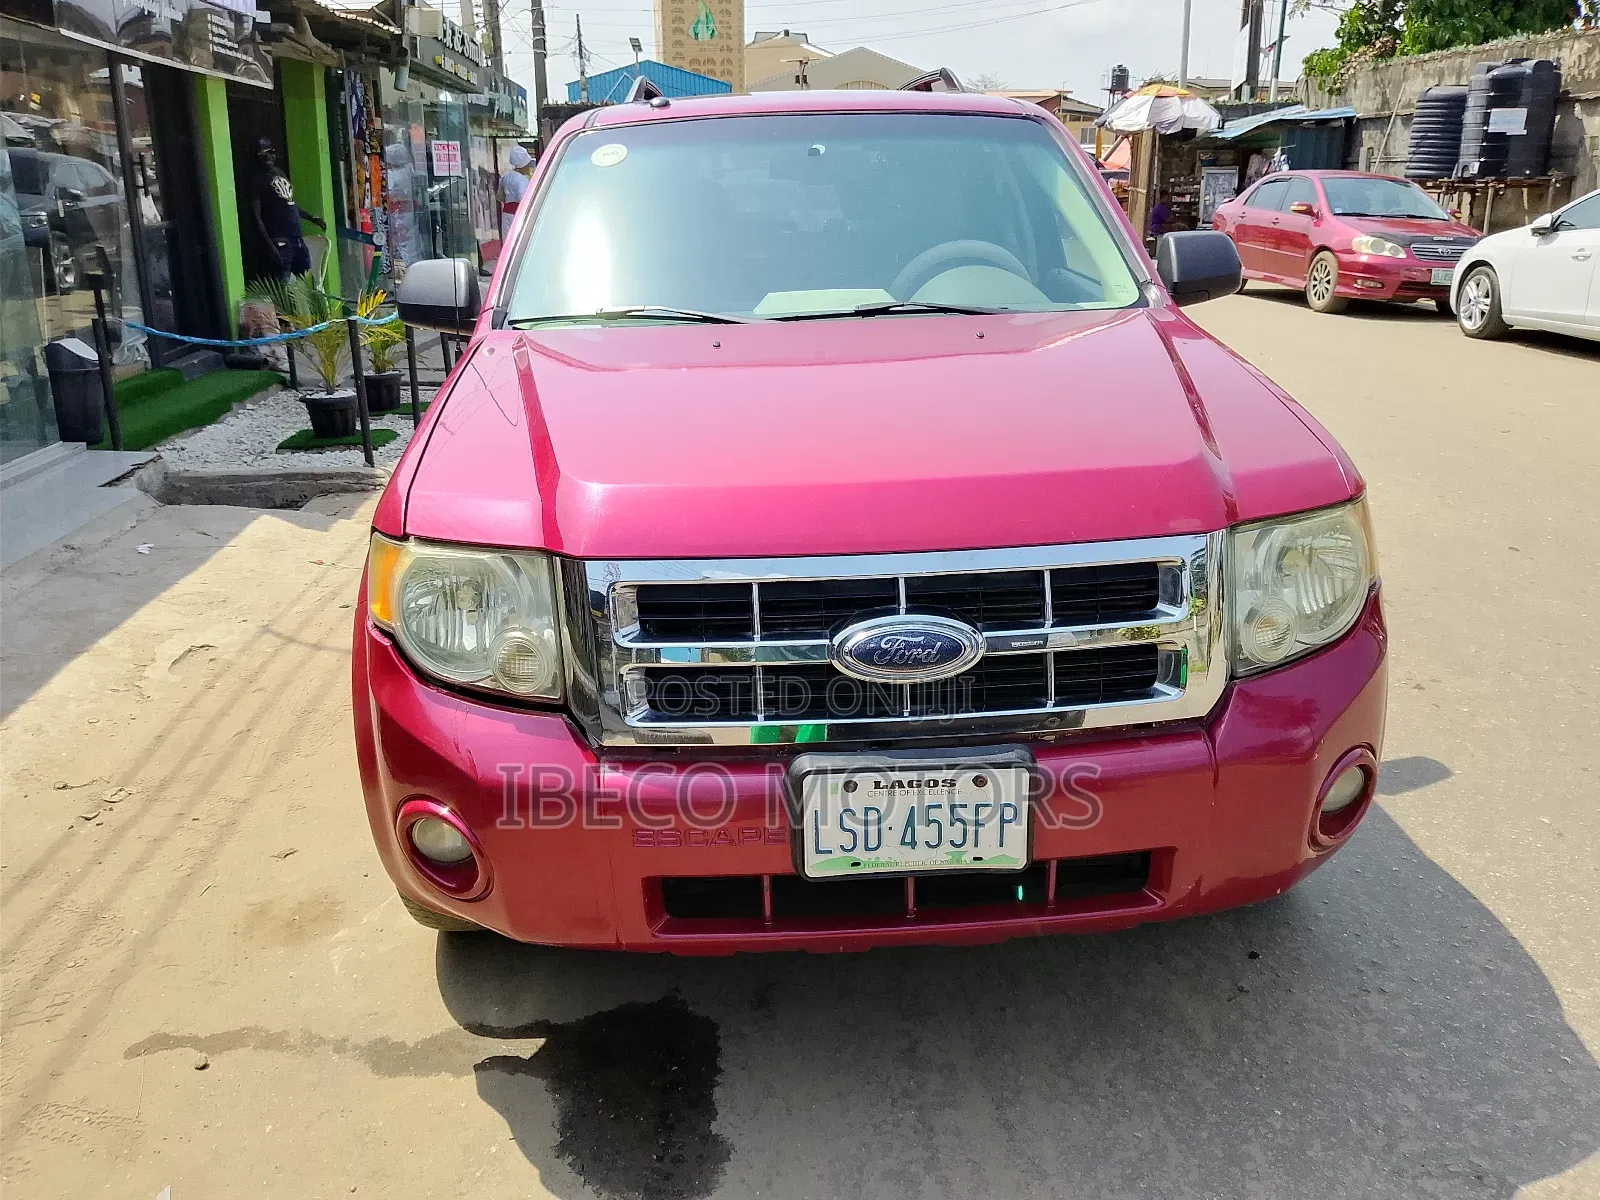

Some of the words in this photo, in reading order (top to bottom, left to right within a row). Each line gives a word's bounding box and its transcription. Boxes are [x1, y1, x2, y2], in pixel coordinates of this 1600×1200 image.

[874, 635, 944, 665] Ford
[873, 778, 957, 790] LAGOS
[867, 790, 897, 798] CENTRE
[899, 789, 910, 797] OF
[912, 788, 962, 796] EXCELLENCE
[631, 826, 790, 848] ESCAPE
